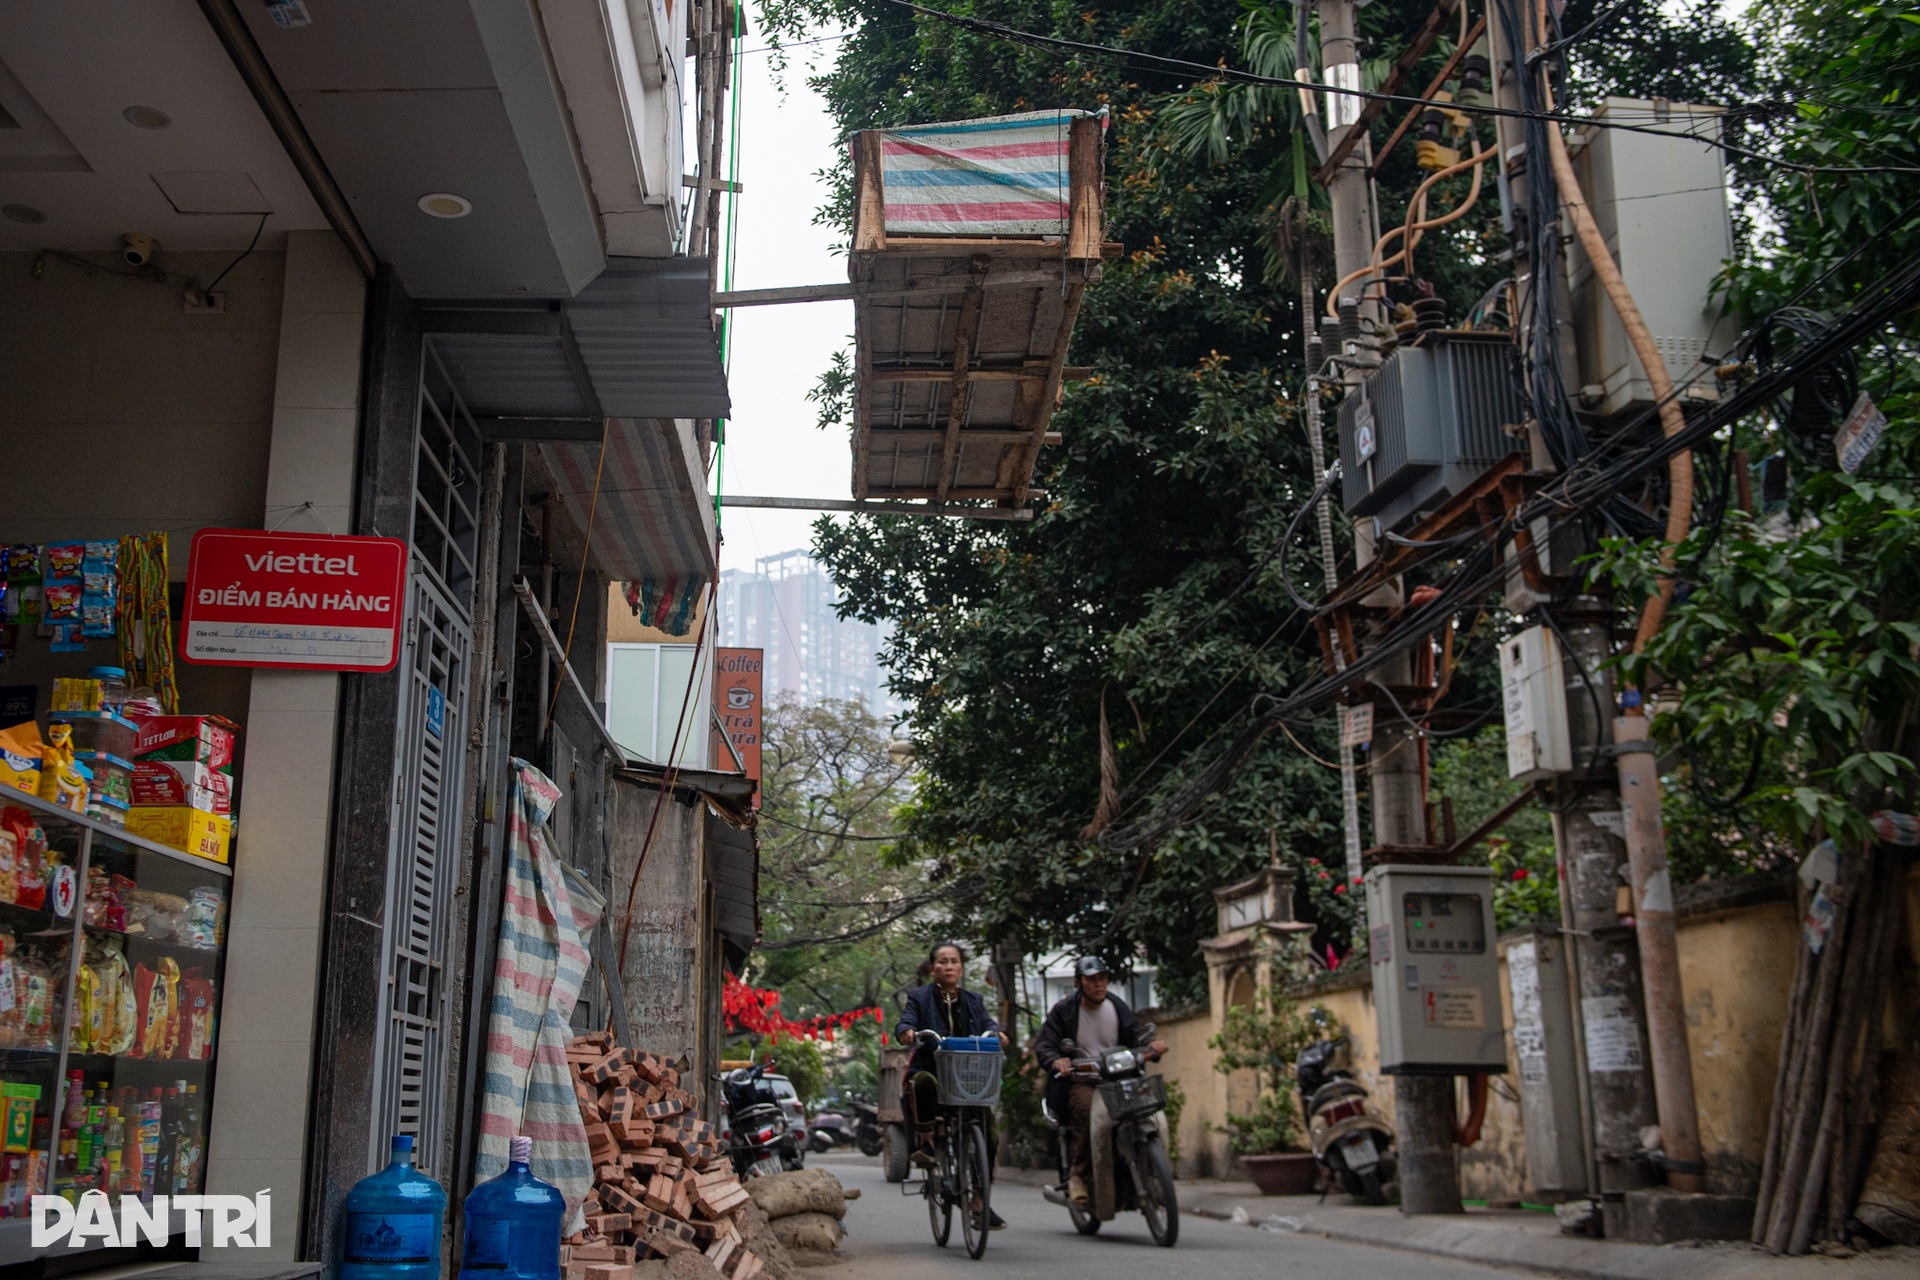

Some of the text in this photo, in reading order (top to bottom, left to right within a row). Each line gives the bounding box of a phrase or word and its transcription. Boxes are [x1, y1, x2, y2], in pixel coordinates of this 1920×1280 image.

[244, 550, 359, 576] viettel
[198, 581, 390, 612] ĐIỂM BÁN HÀNG
[720, 654, 761, 673] Coffee
[434, 695, 440, 719] 3
[723, 713, 753, 728] Trà
